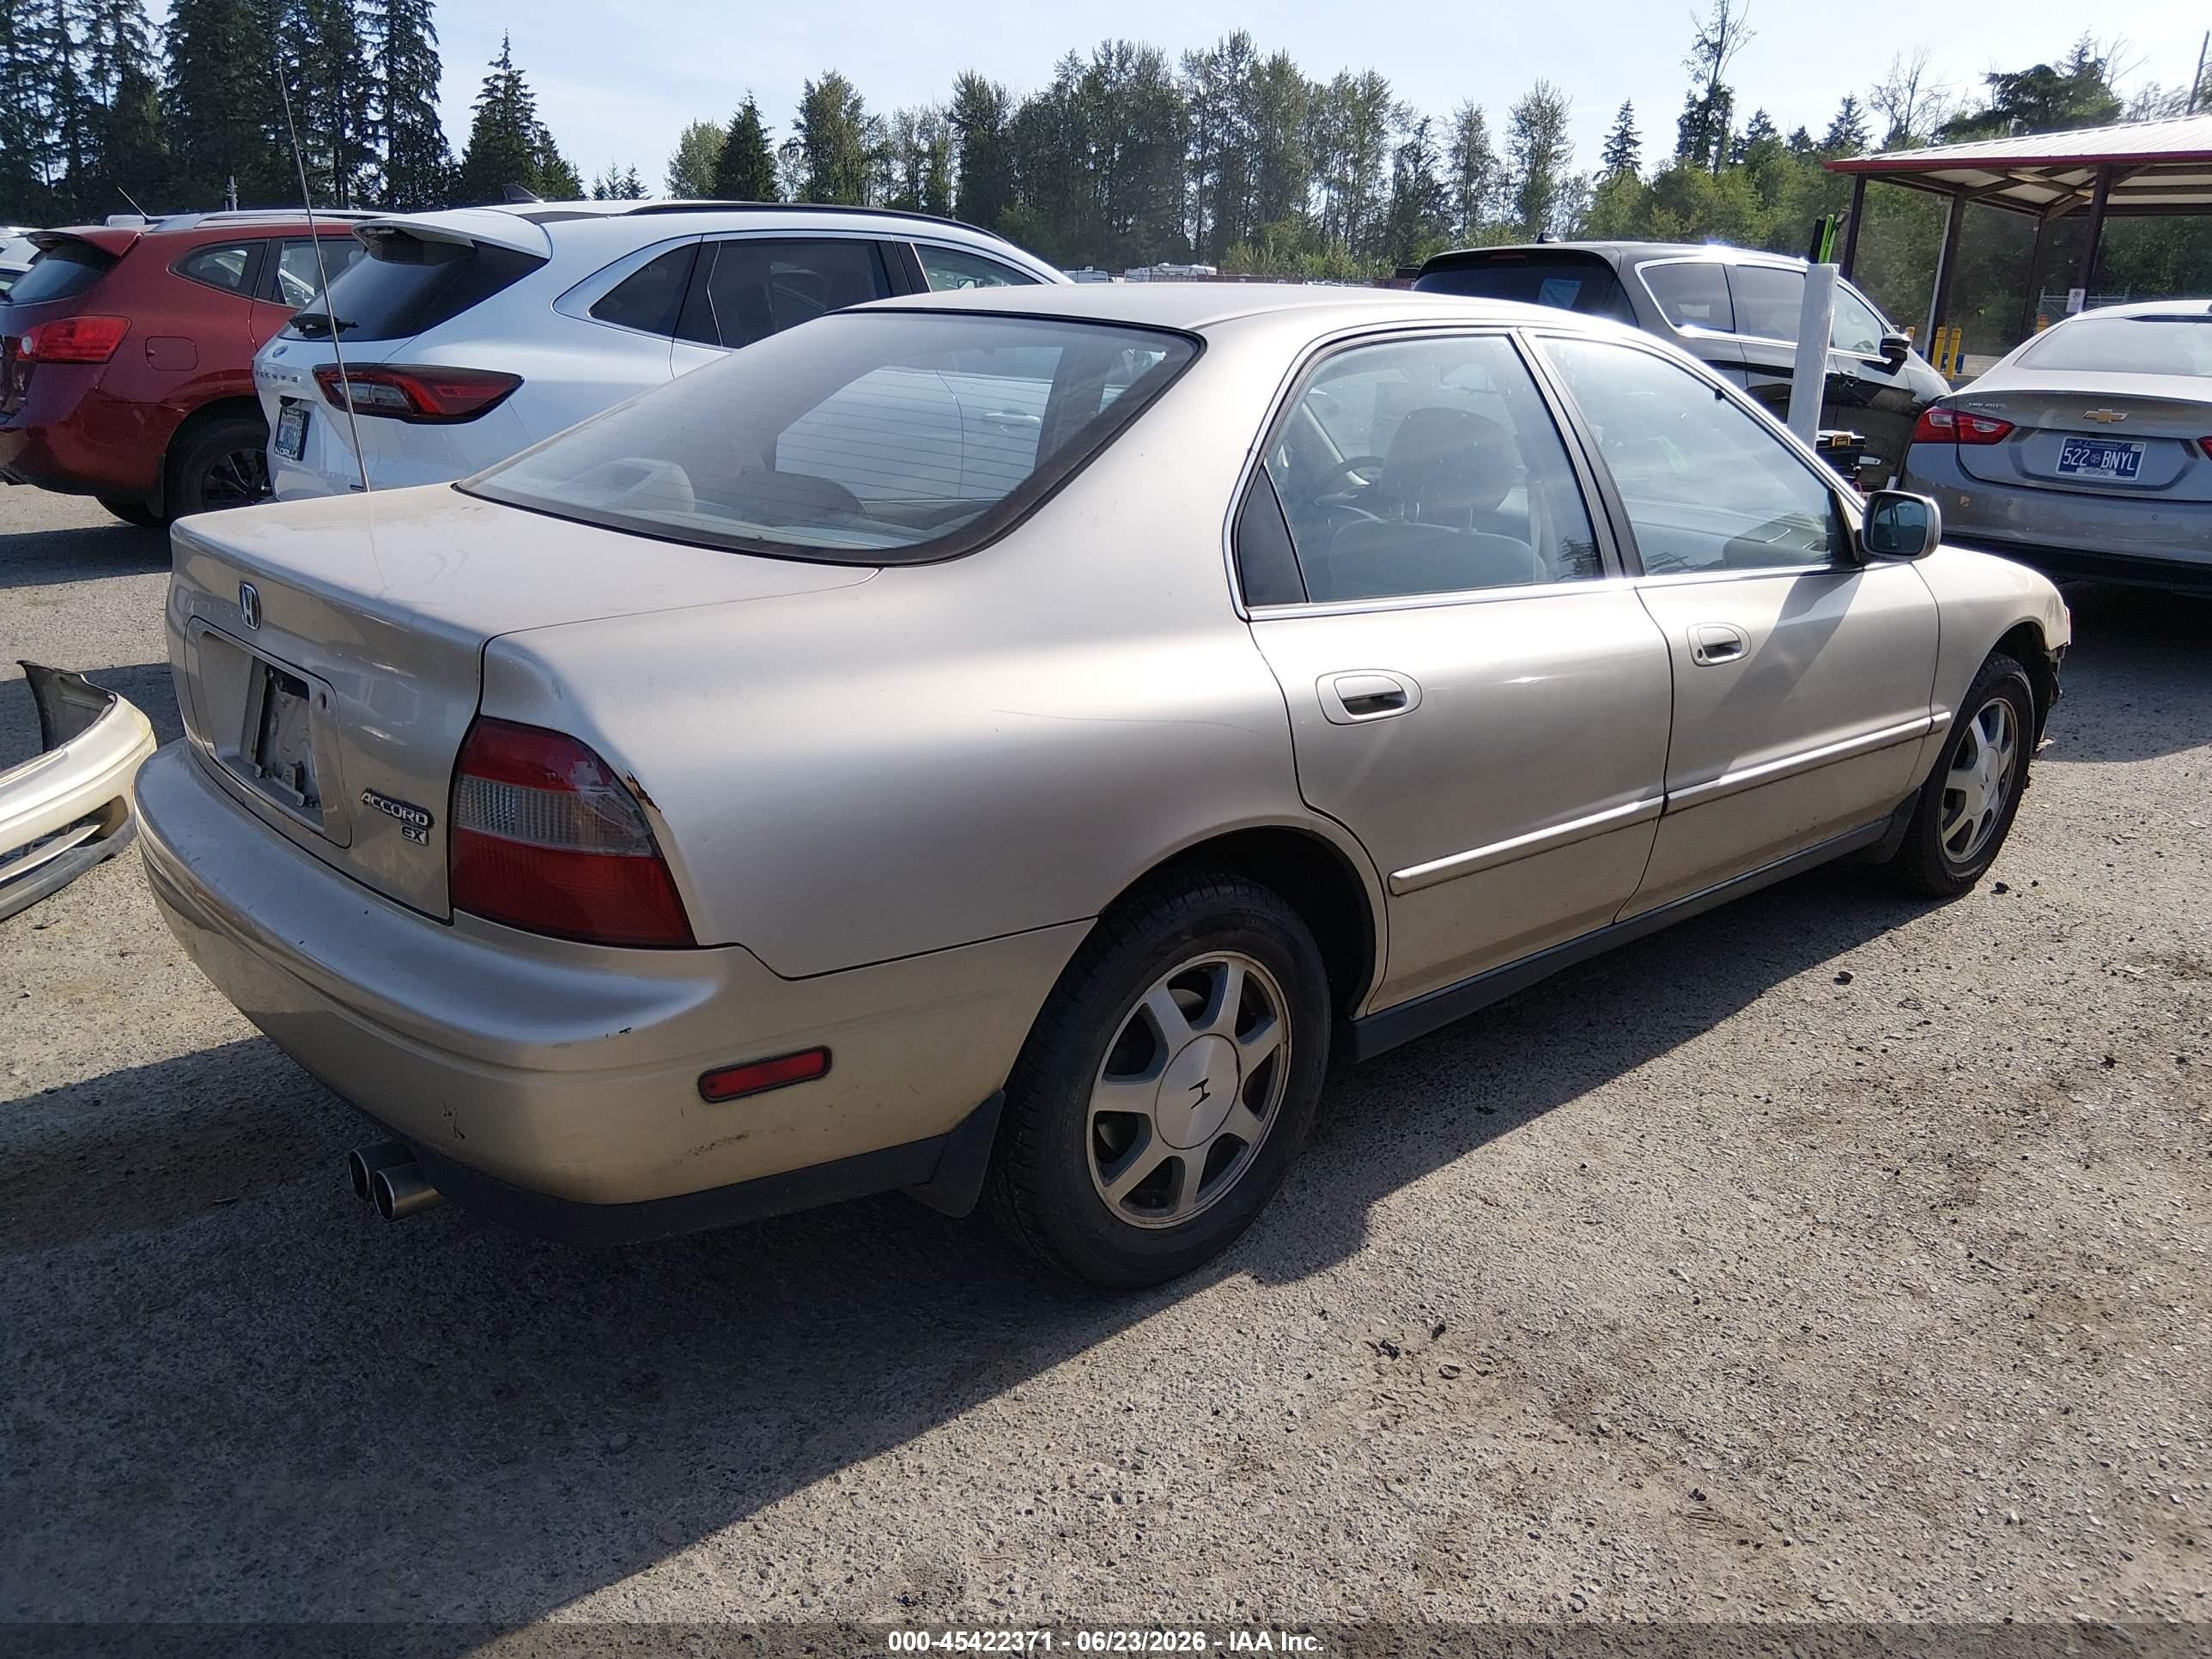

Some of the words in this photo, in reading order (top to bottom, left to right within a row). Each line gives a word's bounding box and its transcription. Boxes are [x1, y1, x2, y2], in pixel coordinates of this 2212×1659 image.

[2063, 447, 2090, 466] 522
[2100, 450, 2136, 471] BNYL
[361, 791, 428, 827] ACCORD
[401, 825, 426, 844] EX
